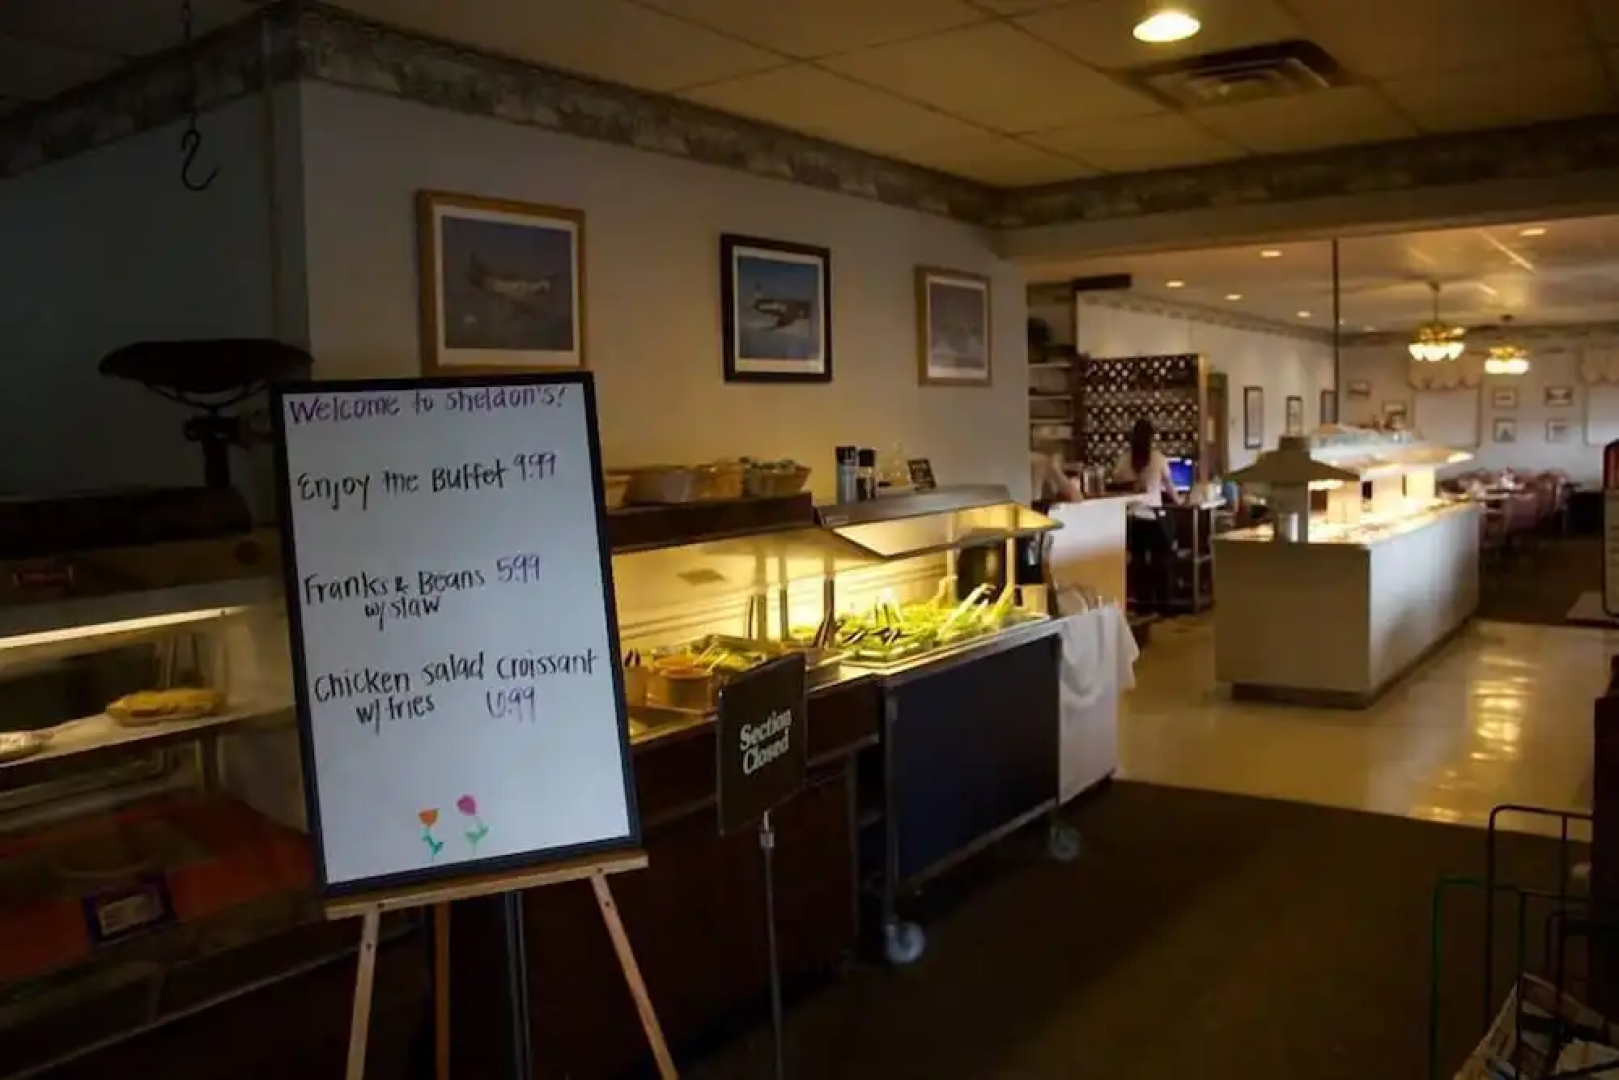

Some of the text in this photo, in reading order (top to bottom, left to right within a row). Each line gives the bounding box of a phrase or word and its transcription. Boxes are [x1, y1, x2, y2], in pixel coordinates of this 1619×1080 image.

[289, 394, 400, 426] Welcome
[414, 390, 434, 415] to
[297, 471, 371, 511] Enjoy
[381, 468, 420, 494] the
[303, 571, 389, 605] Franks
[418, 567, 486, 596] Beans
[385, 694, 436, 721] fries
[739, 708, 792, 752] Section
[742, 726, 790, 776] Closed
